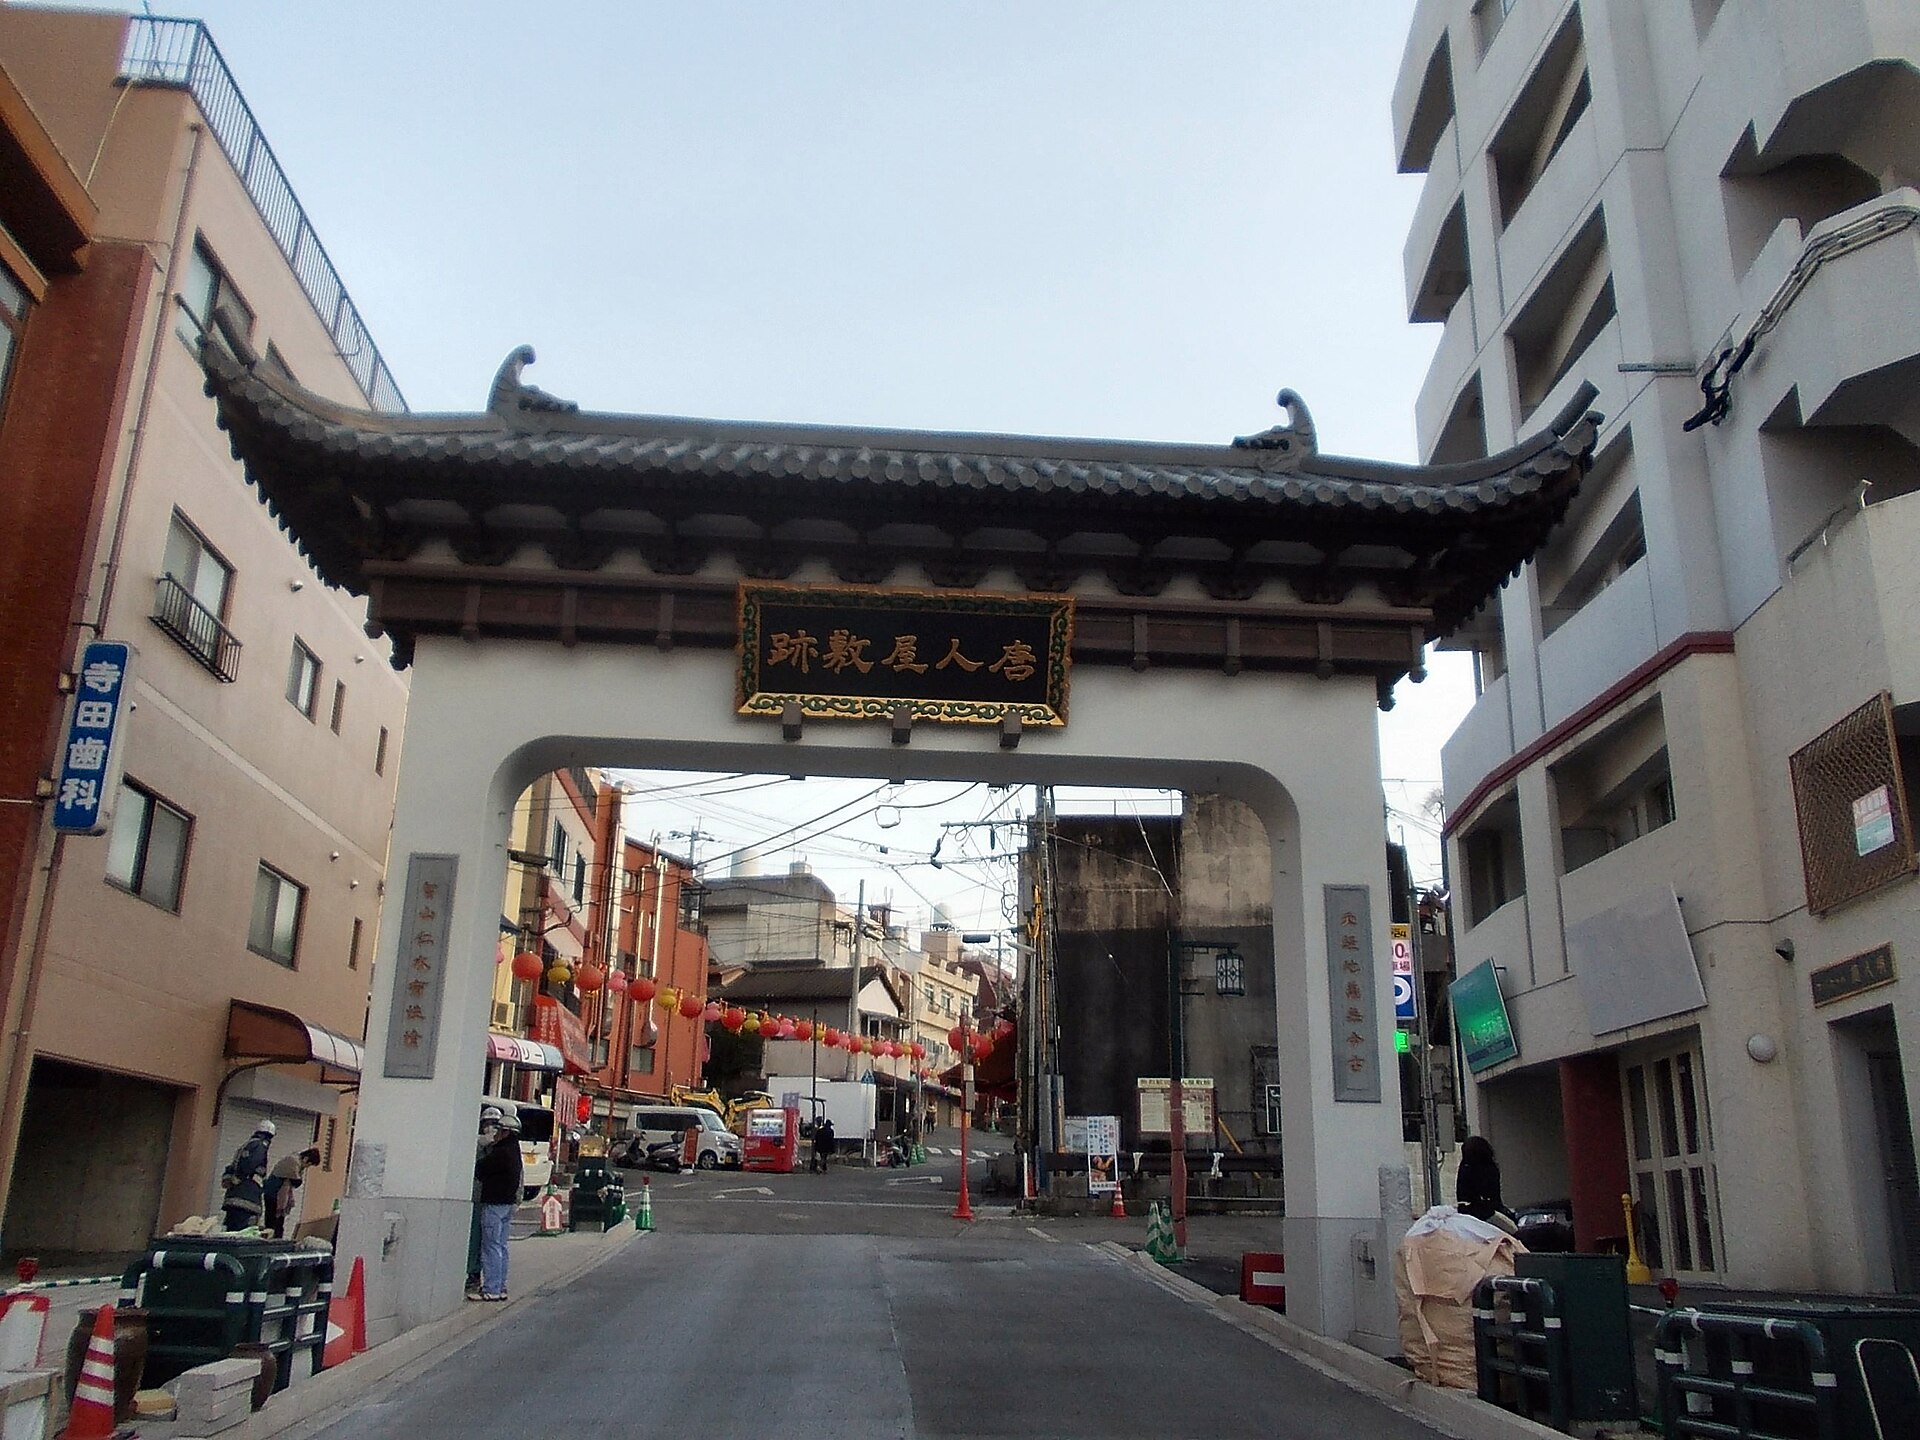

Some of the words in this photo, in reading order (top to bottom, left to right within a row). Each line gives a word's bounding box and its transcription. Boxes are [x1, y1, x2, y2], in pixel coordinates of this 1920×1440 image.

[767, 629, 1038, 682] 唐人屋敷跡
[60, 661, 121, 811] 寺田歯科
[1392, 943, 1410, 960] 0円
